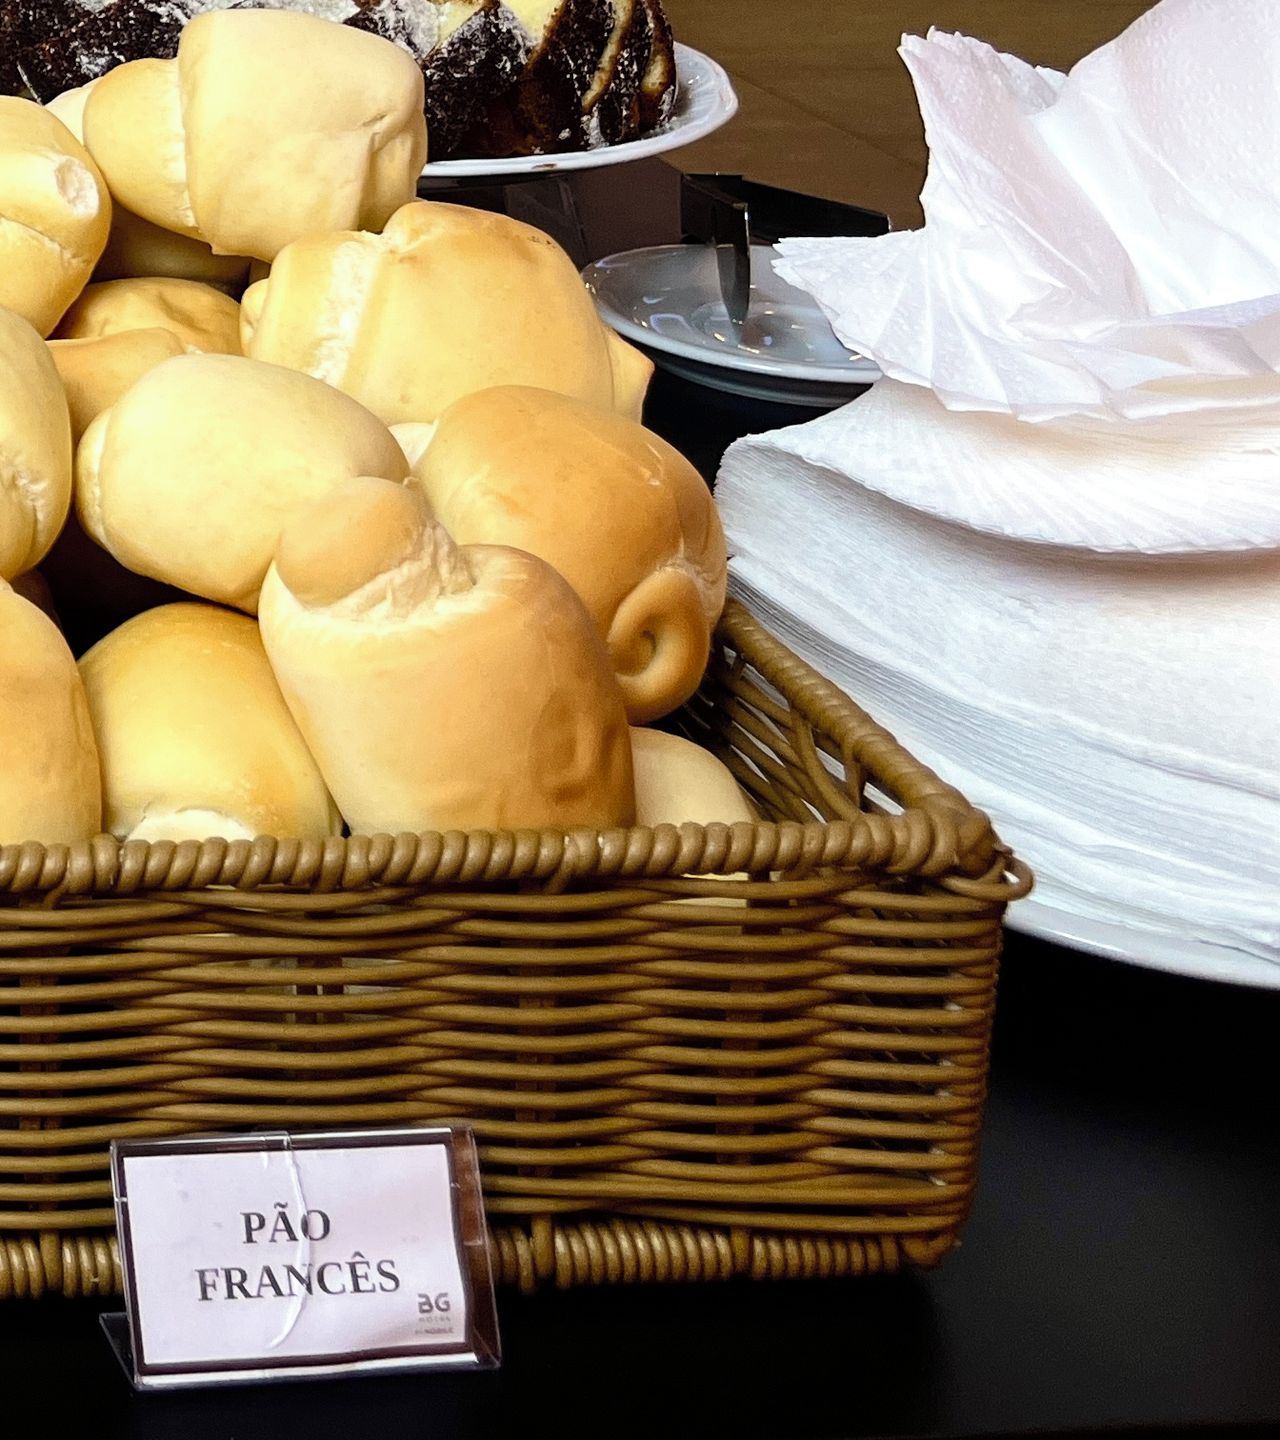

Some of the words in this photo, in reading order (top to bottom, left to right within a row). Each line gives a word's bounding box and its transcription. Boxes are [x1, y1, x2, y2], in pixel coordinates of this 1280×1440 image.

[240, 1202, 331, 1244] PÃO
[194, 1251, 401, 1301] FRANCÊS
[417, 1292, 451, 1313] BG
